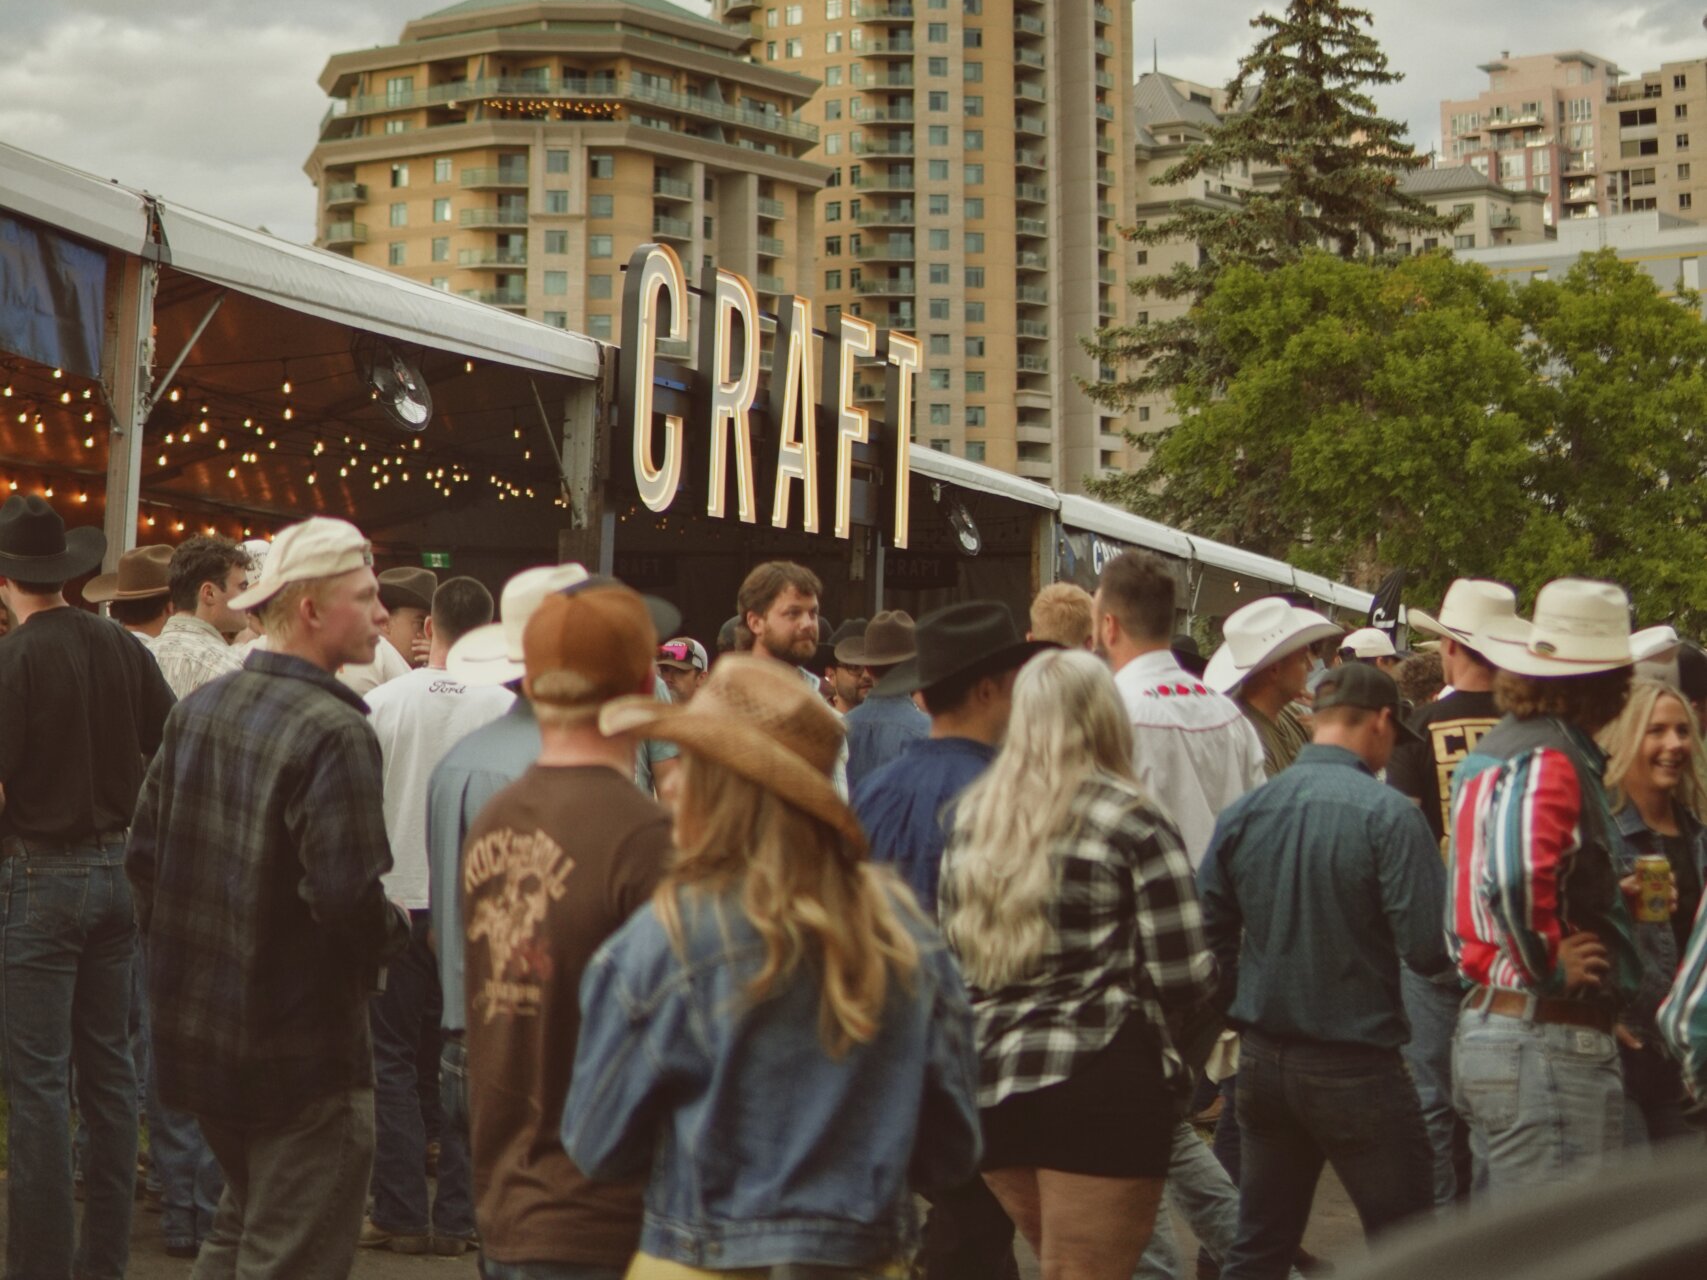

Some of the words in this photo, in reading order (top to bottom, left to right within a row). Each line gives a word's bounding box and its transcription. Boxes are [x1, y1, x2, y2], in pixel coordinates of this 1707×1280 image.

[621, 243, 923, 550] CRAFT
[884, 557, 942, 577] CRAFT
[428, 680, 467, 694] Ford
